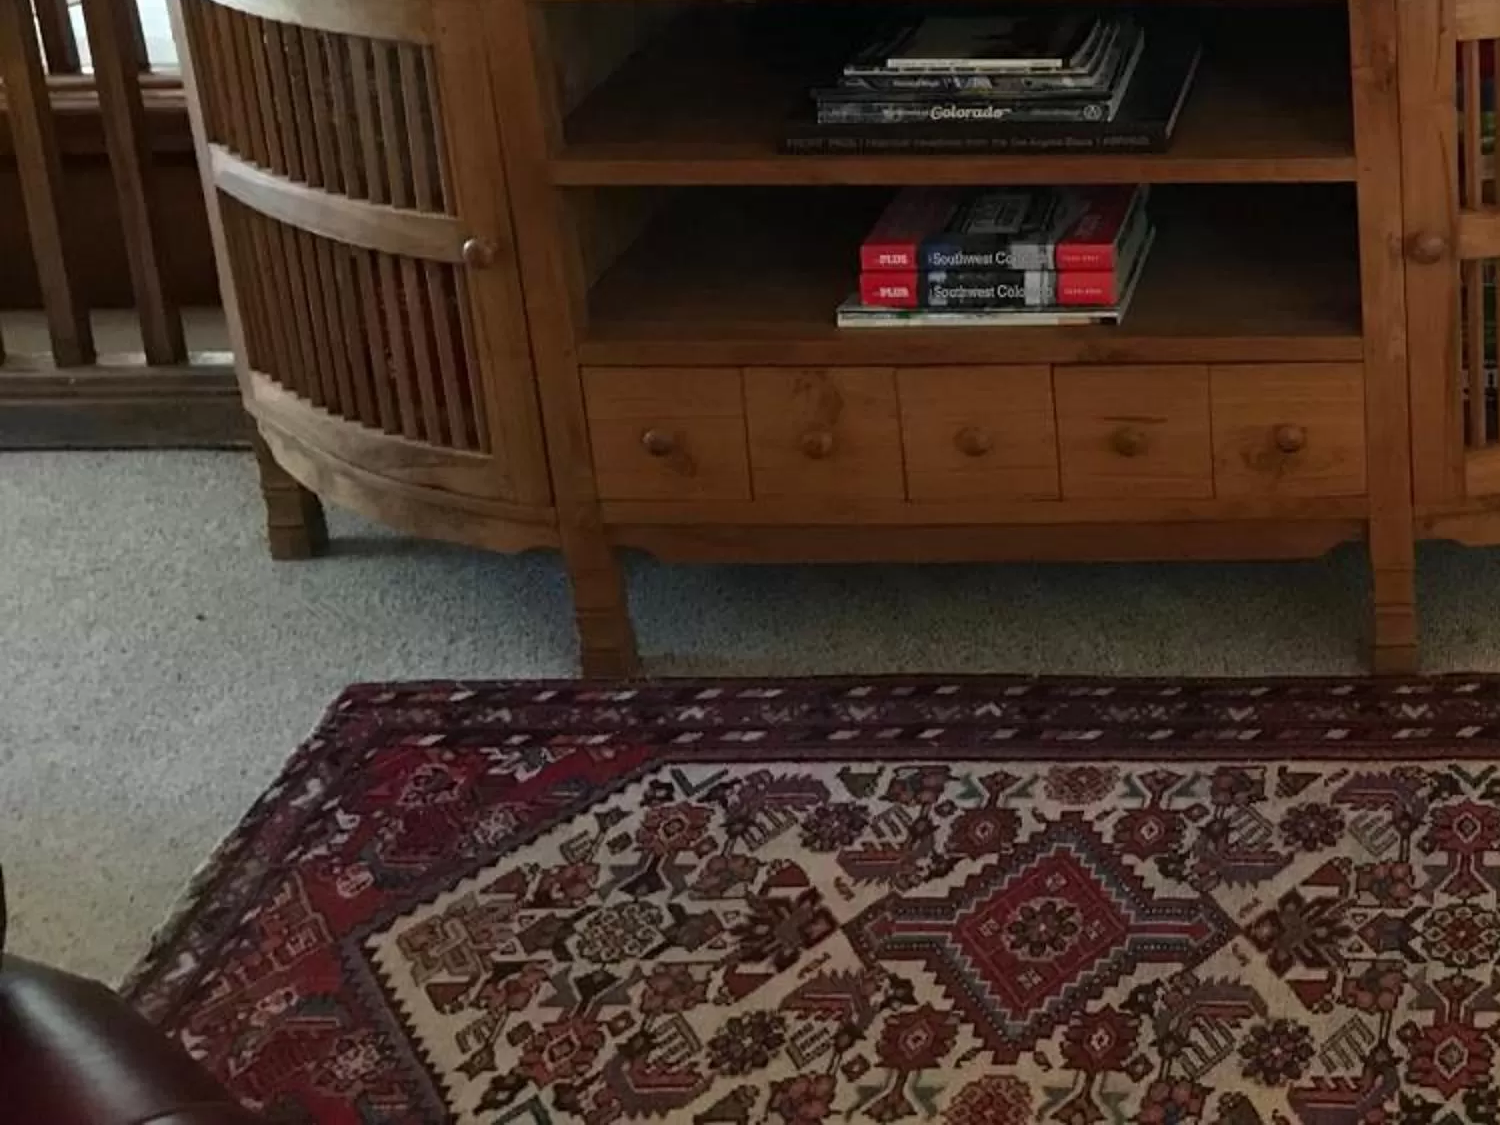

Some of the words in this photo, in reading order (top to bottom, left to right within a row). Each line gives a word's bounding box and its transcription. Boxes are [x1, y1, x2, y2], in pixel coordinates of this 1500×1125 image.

[930, 105, 1004, 119] Colorado
[933, 249, 993, 266] Southwest
[933, 283, 996, 300] Southwest
